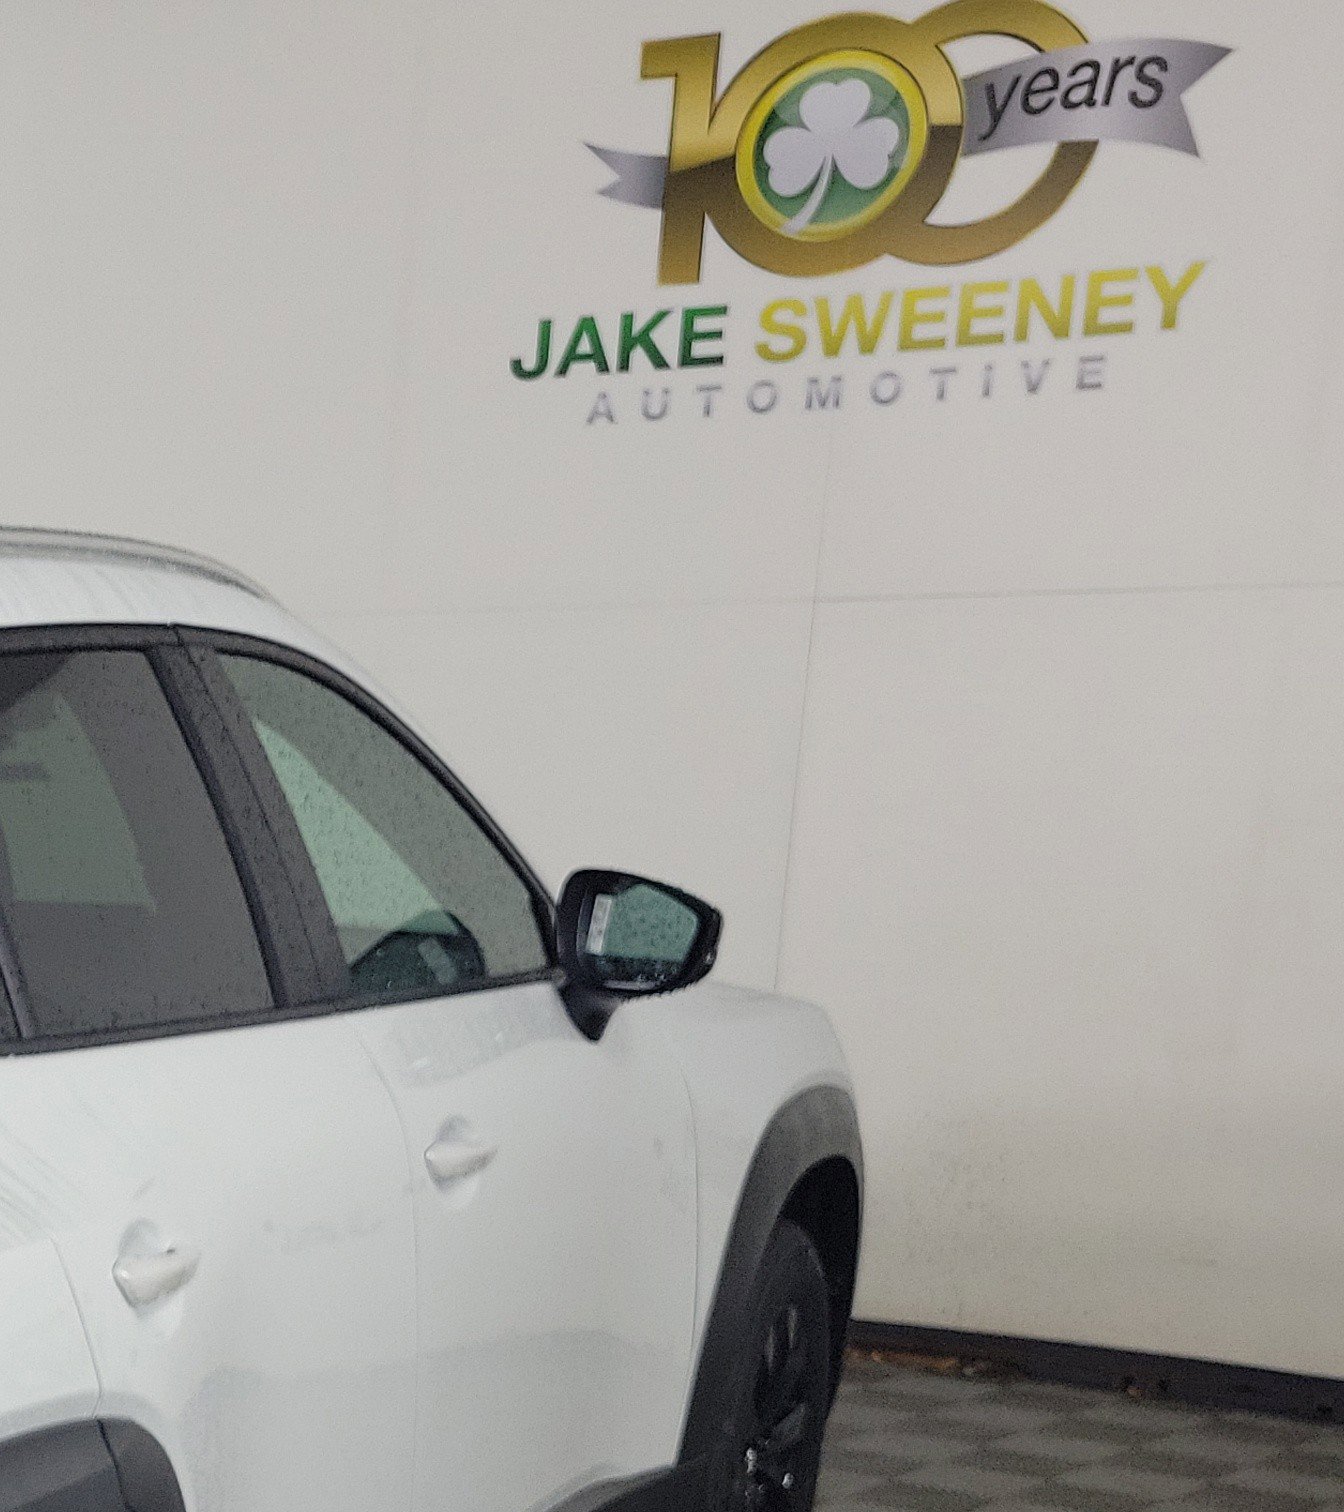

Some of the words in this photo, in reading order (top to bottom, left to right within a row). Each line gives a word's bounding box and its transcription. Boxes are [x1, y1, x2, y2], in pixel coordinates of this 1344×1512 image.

[639, 0, 1100, 286] 100
[976, 47, 1170, 141] years
[510, 304, 730, 382] JAKE
[753, 261, 1208, 364] SWEENEY
[584, 354, 1109, 426] AUTOMOTIVE
